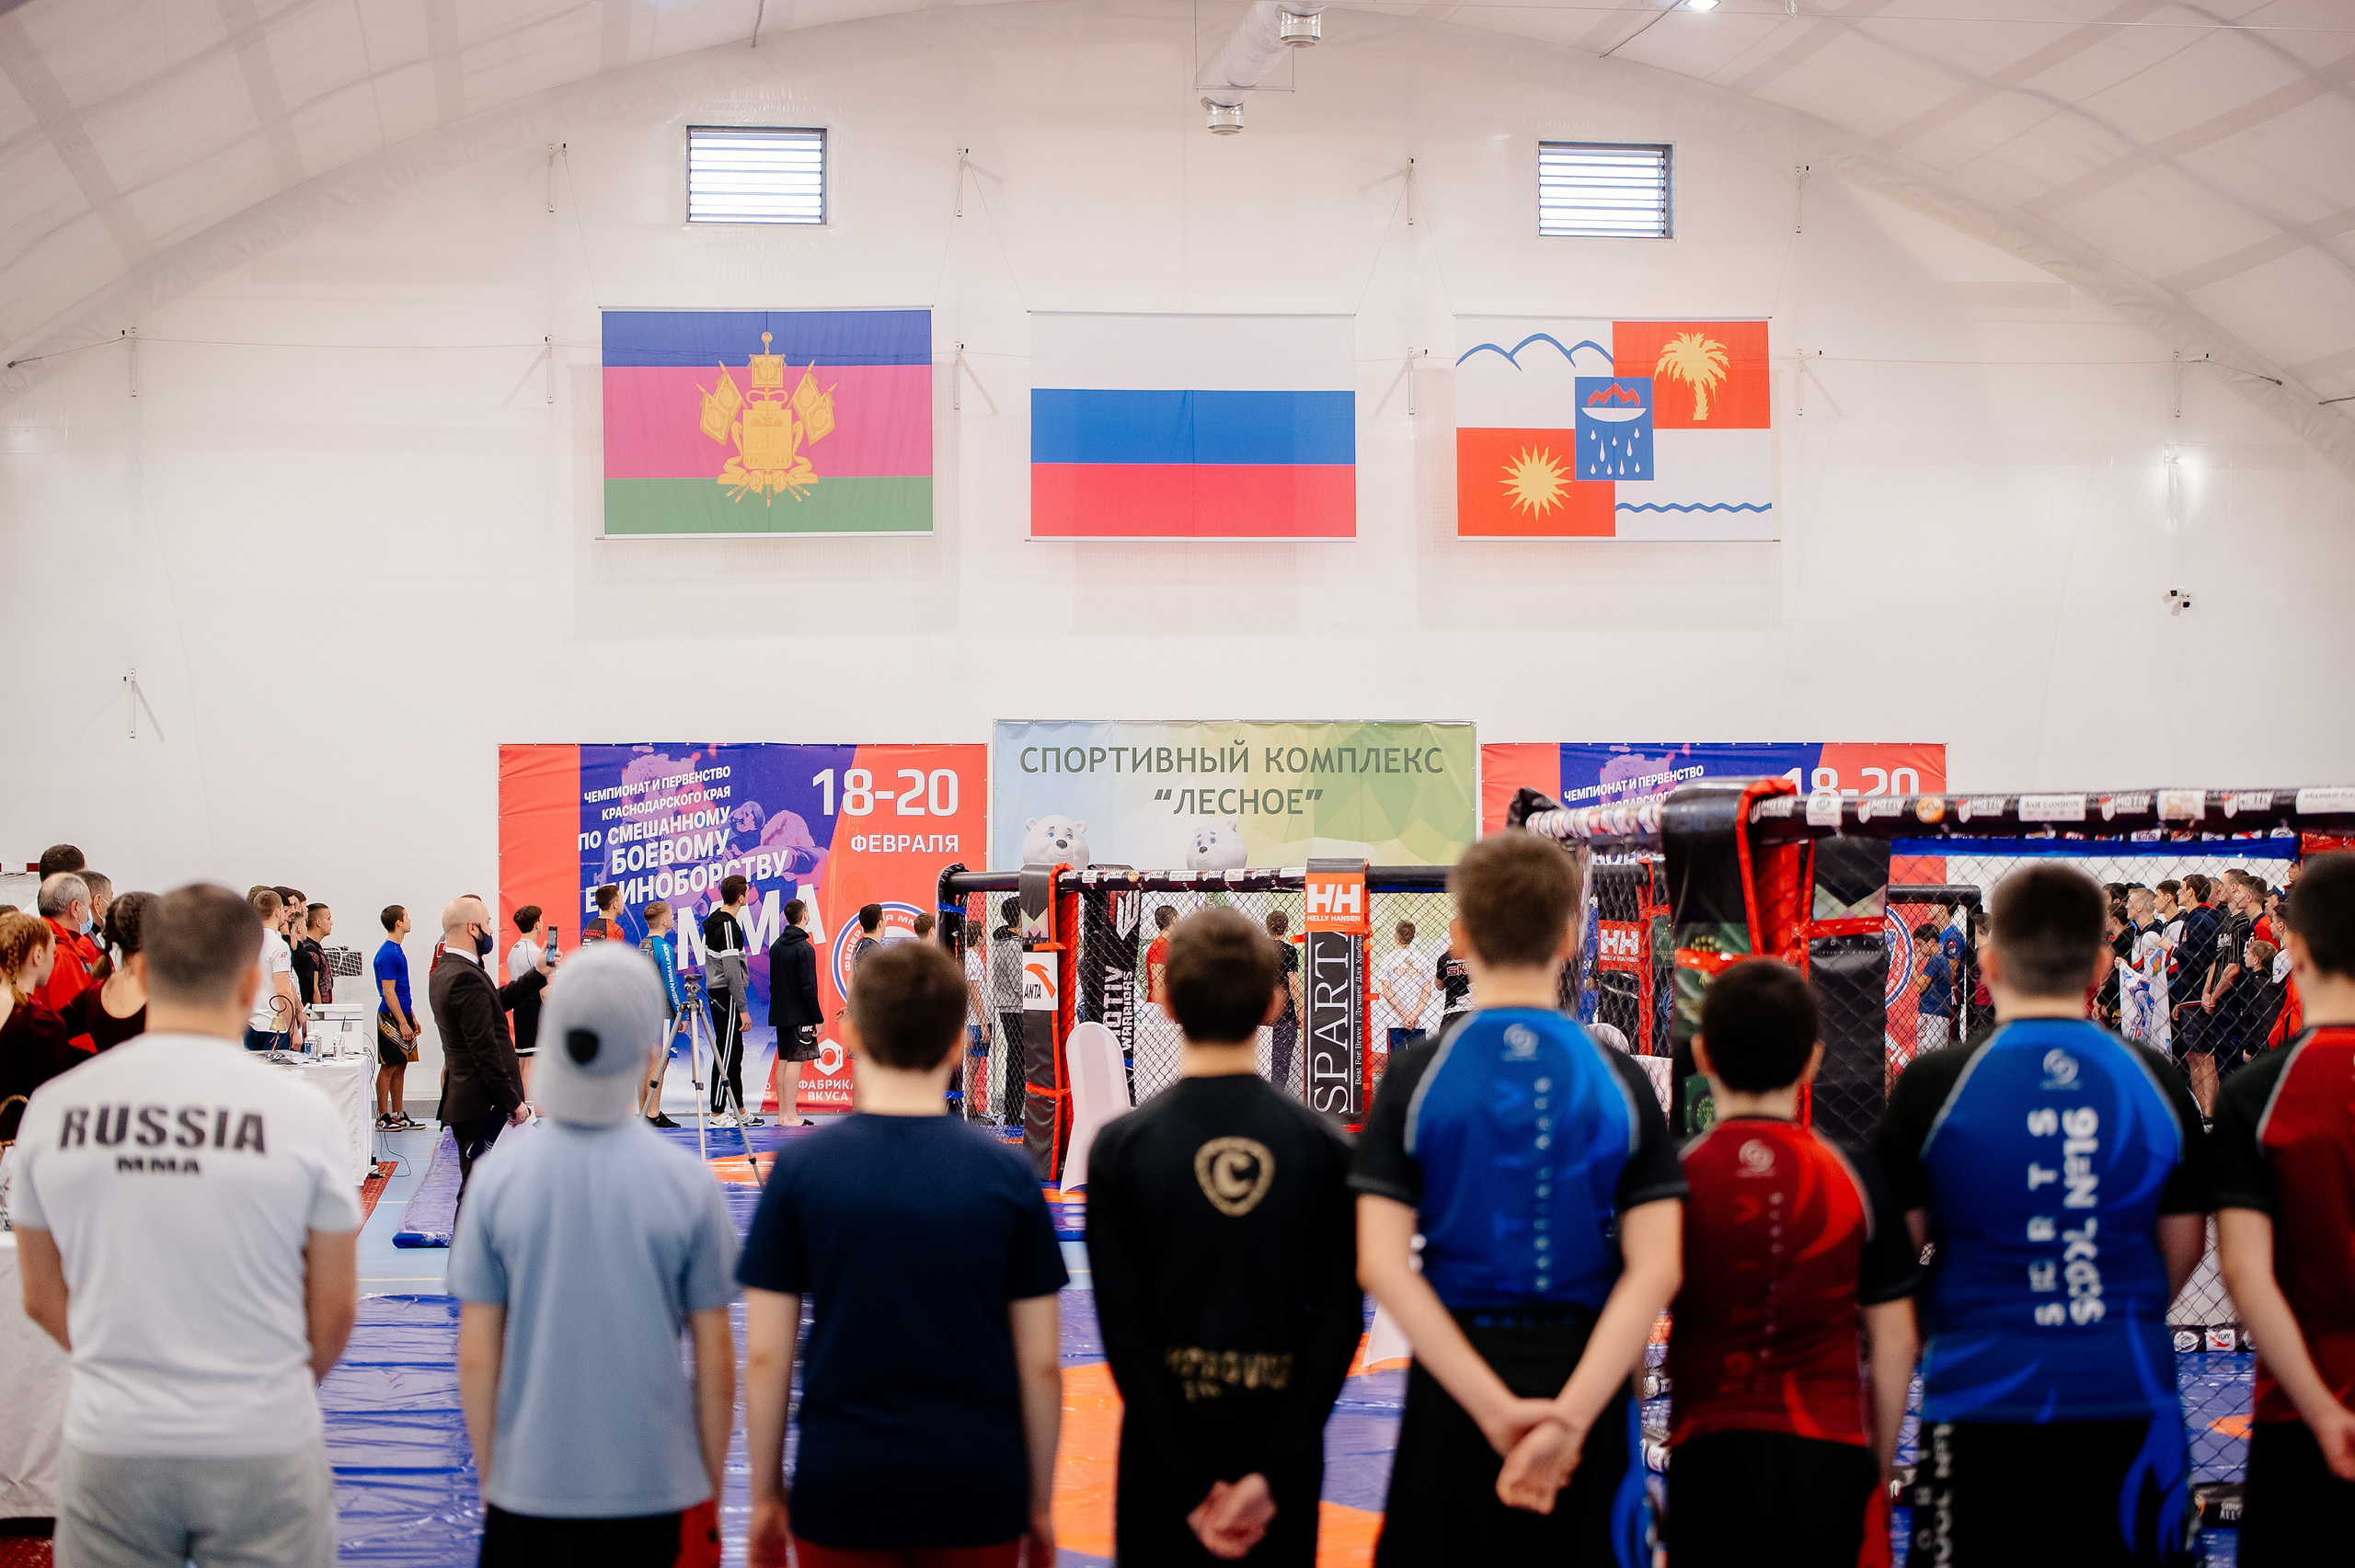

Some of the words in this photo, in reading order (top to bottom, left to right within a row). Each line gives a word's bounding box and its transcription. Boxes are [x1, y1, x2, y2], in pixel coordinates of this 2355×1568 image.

[1020, 739, 1249, 773] СПОРТИВНЫЙ
[1266, 747, 1443, 773] КОМПЛЕКС
[584, 782, 650, 804] ЧЕМПИОНАТ
[652, 780, 661, 791] И
[661, 765, 731, 789] ПЕРВЕНСТВО
[812, 768, 959, 817] 18-20
[1564, 780, 1627, 802] ЧЕМПИОНАТ
[1627, 779, 1637, 788] И
[1637, 765, 1705, 788] ПЕРВЕНСТВО
[602, 792, 702, 820] КРАСНОДАРСКОГО
[703, 785, 731, 802] КРАЯ
[578, 830, 602, 851] ПО
[608, 806, 731, 844] СМЕШАННОМУ
[851, 834, 959, 853] ФЕВРАЛЯ
[612, 829, 730, 875] БОЕВОМУ
[1355, 933, 1363, 964] Храбры
[1024, 983, 1041, 1000] ANTA
[1355, 967, 1363, 984] Для
[1103, 965, 1123, 1039] OTIV
[1355, 985, 1363, 1017] Лучшее
[1314, 932, 1349, 1114] SPART
[808, 1091, 849, 1101] ВКУСА
[58, 1102, 268, 1155] RUSSIA
[116, 1156, 201, 1176] MMA
